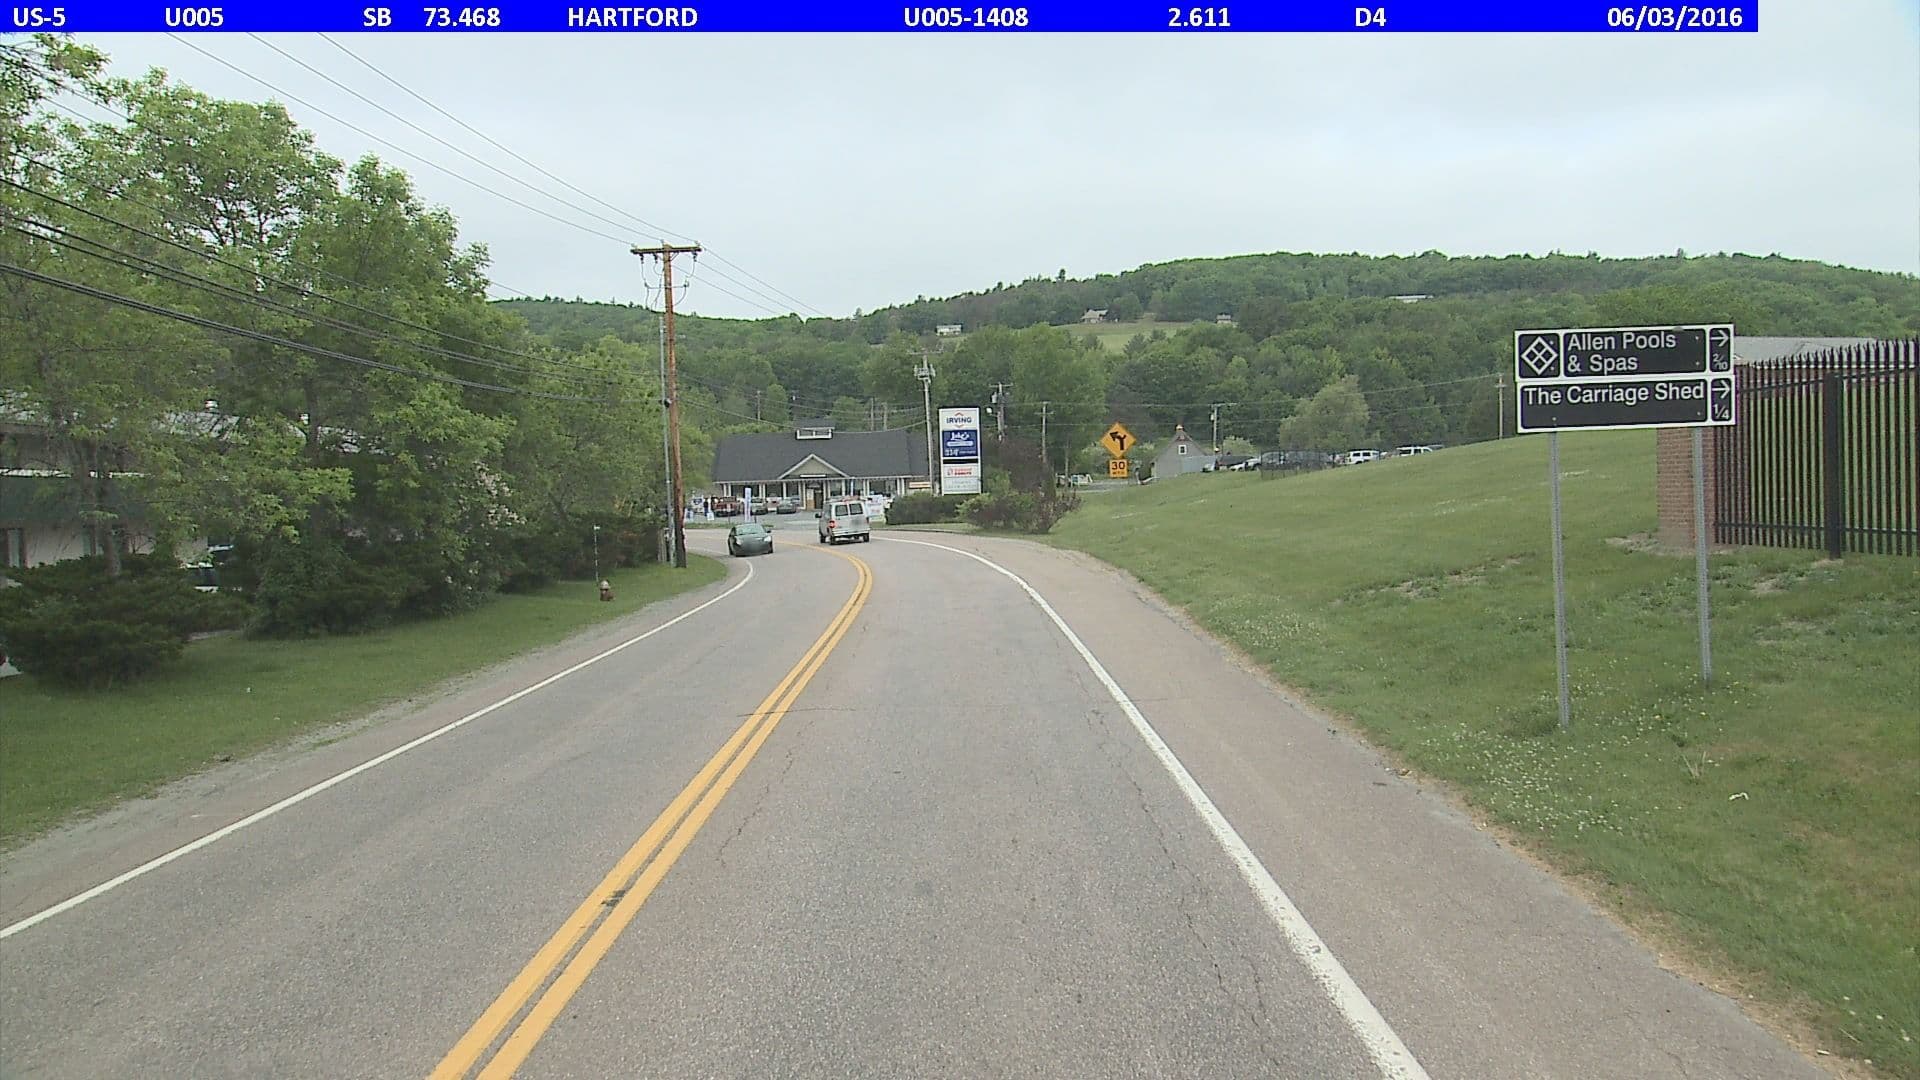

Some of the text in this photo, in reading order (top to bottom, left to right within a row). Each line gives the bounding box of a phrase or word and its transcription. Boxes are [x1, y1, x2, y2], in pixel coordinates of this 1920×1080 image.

[1567, 331, 1676, 351] Allen Pools
[1567, 354, 1638, 375] & Spas
[1523, 381, 1704, 406] The Carriage Shed
[1713, 403, 1730, 420] 1/4
[1111, 461, 1125, 470] 30
